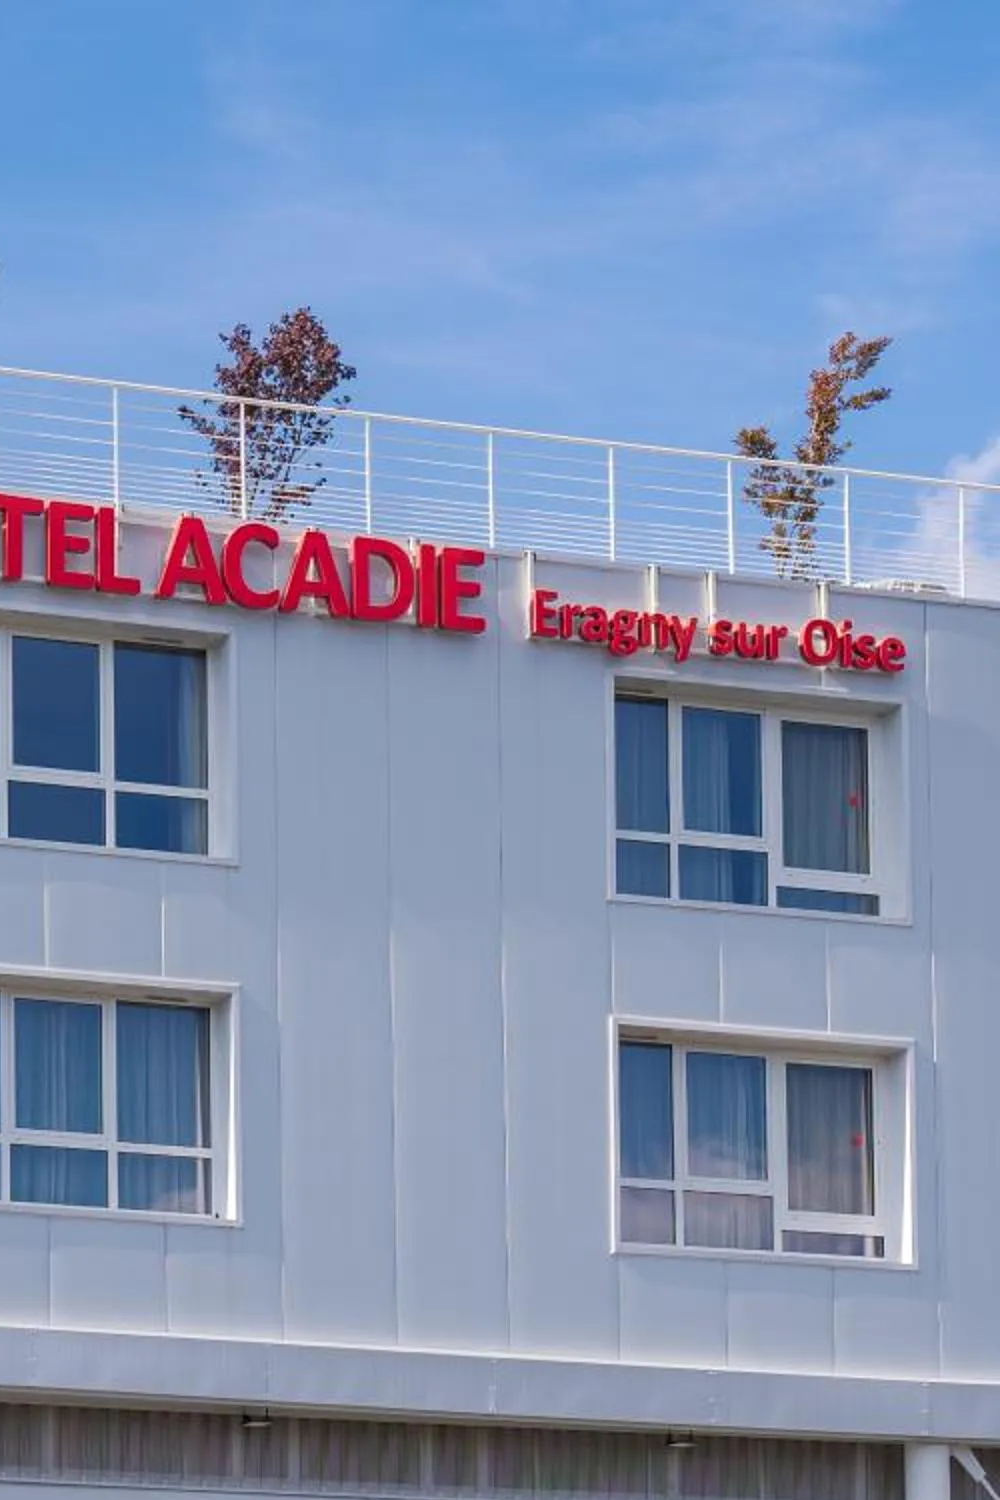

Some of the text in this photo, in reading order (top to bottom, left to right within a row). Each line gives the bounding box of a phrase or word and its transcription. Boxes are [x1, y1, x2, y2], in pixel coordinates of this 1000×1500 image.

[154, 515, 487, 634] ACADIE
[531, 590, 907, 672] Eragny sur Oise
